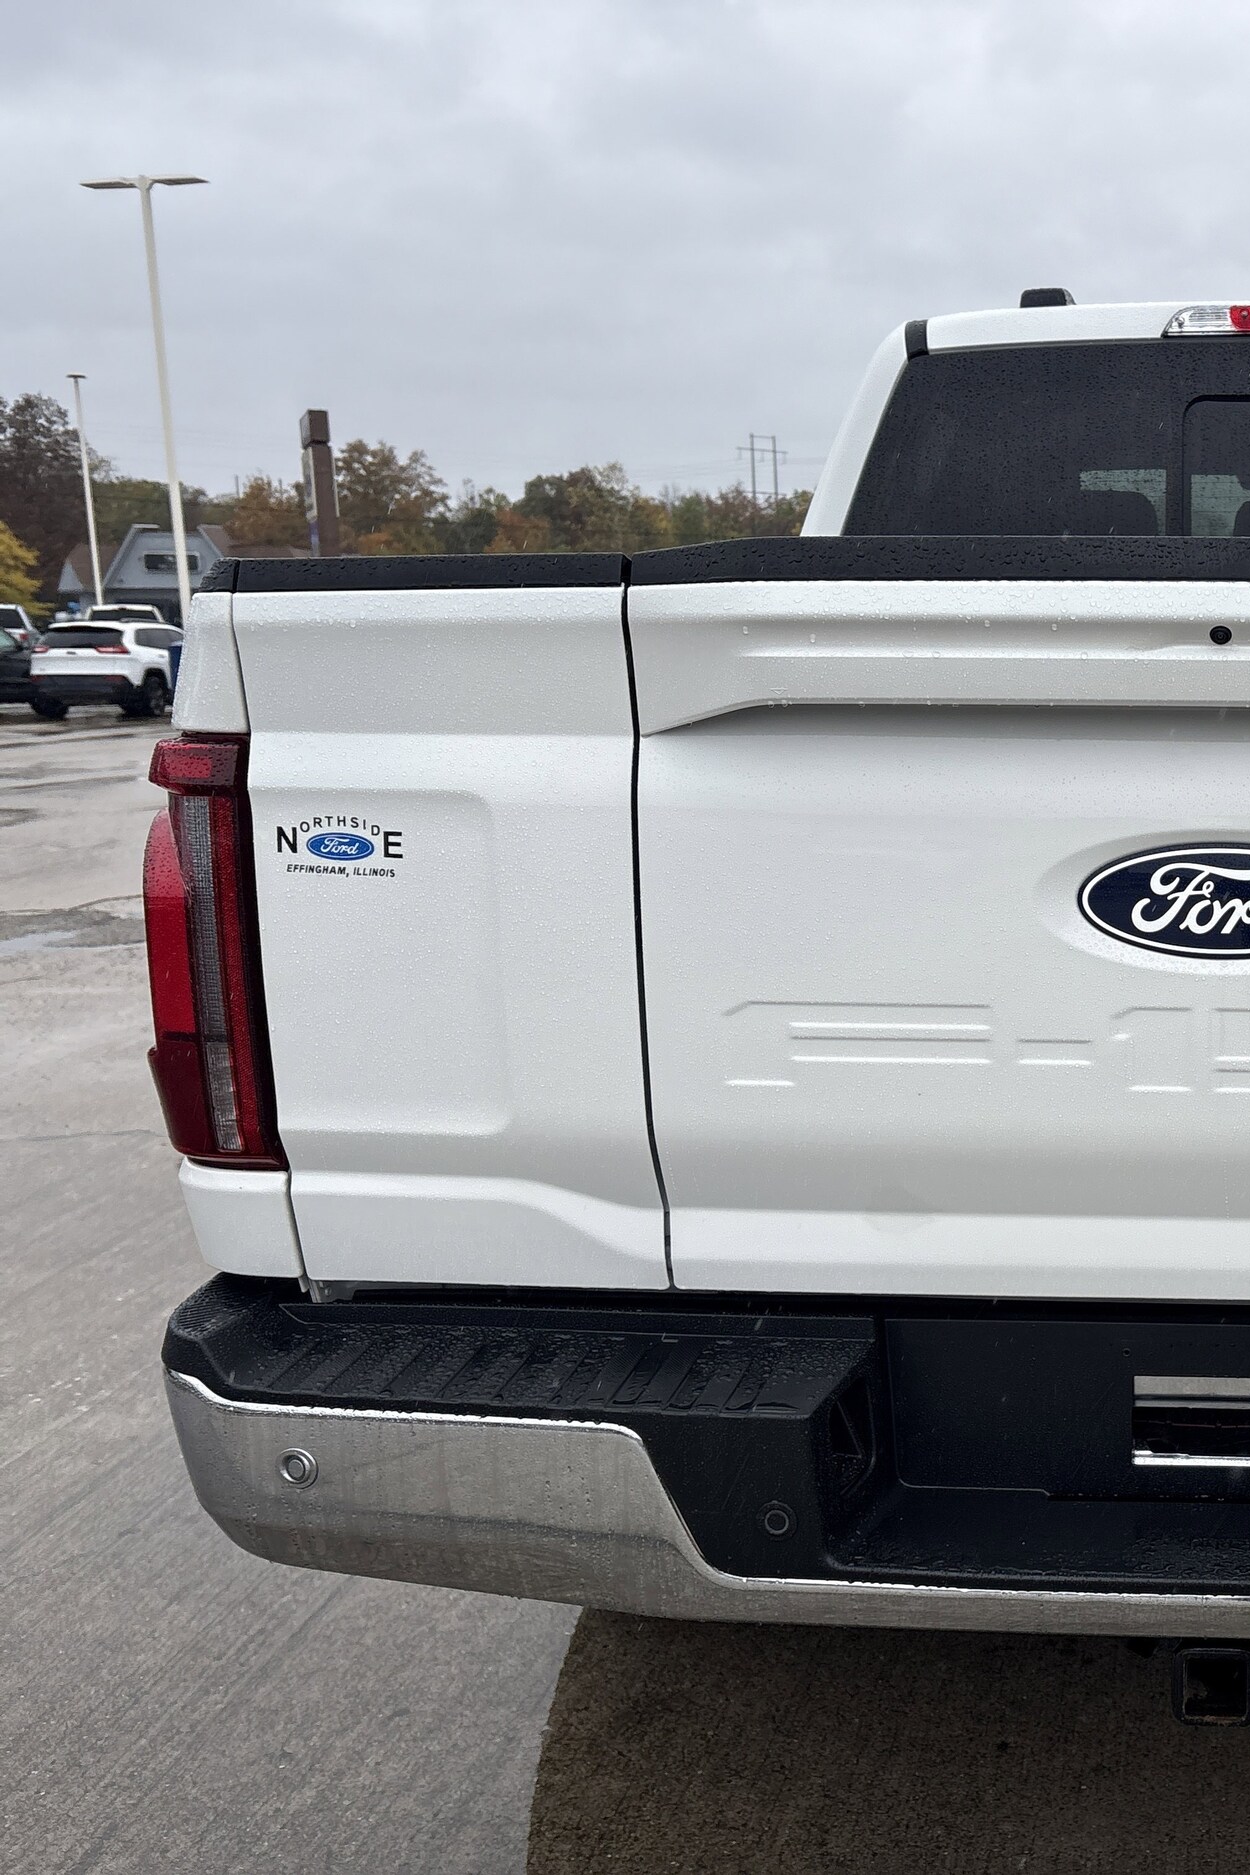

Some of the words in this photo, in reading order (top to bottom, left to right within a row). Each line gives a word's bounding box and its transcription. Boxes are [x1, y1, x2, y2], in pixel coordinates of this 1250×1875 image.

[276, 815, 403, 859] NORTHSIDE
[320, 836, 360, 855] Ford
[286, 863, 350, 878] EFFINGHAM,
[352, 866, 396, 878] ILLINOIS
